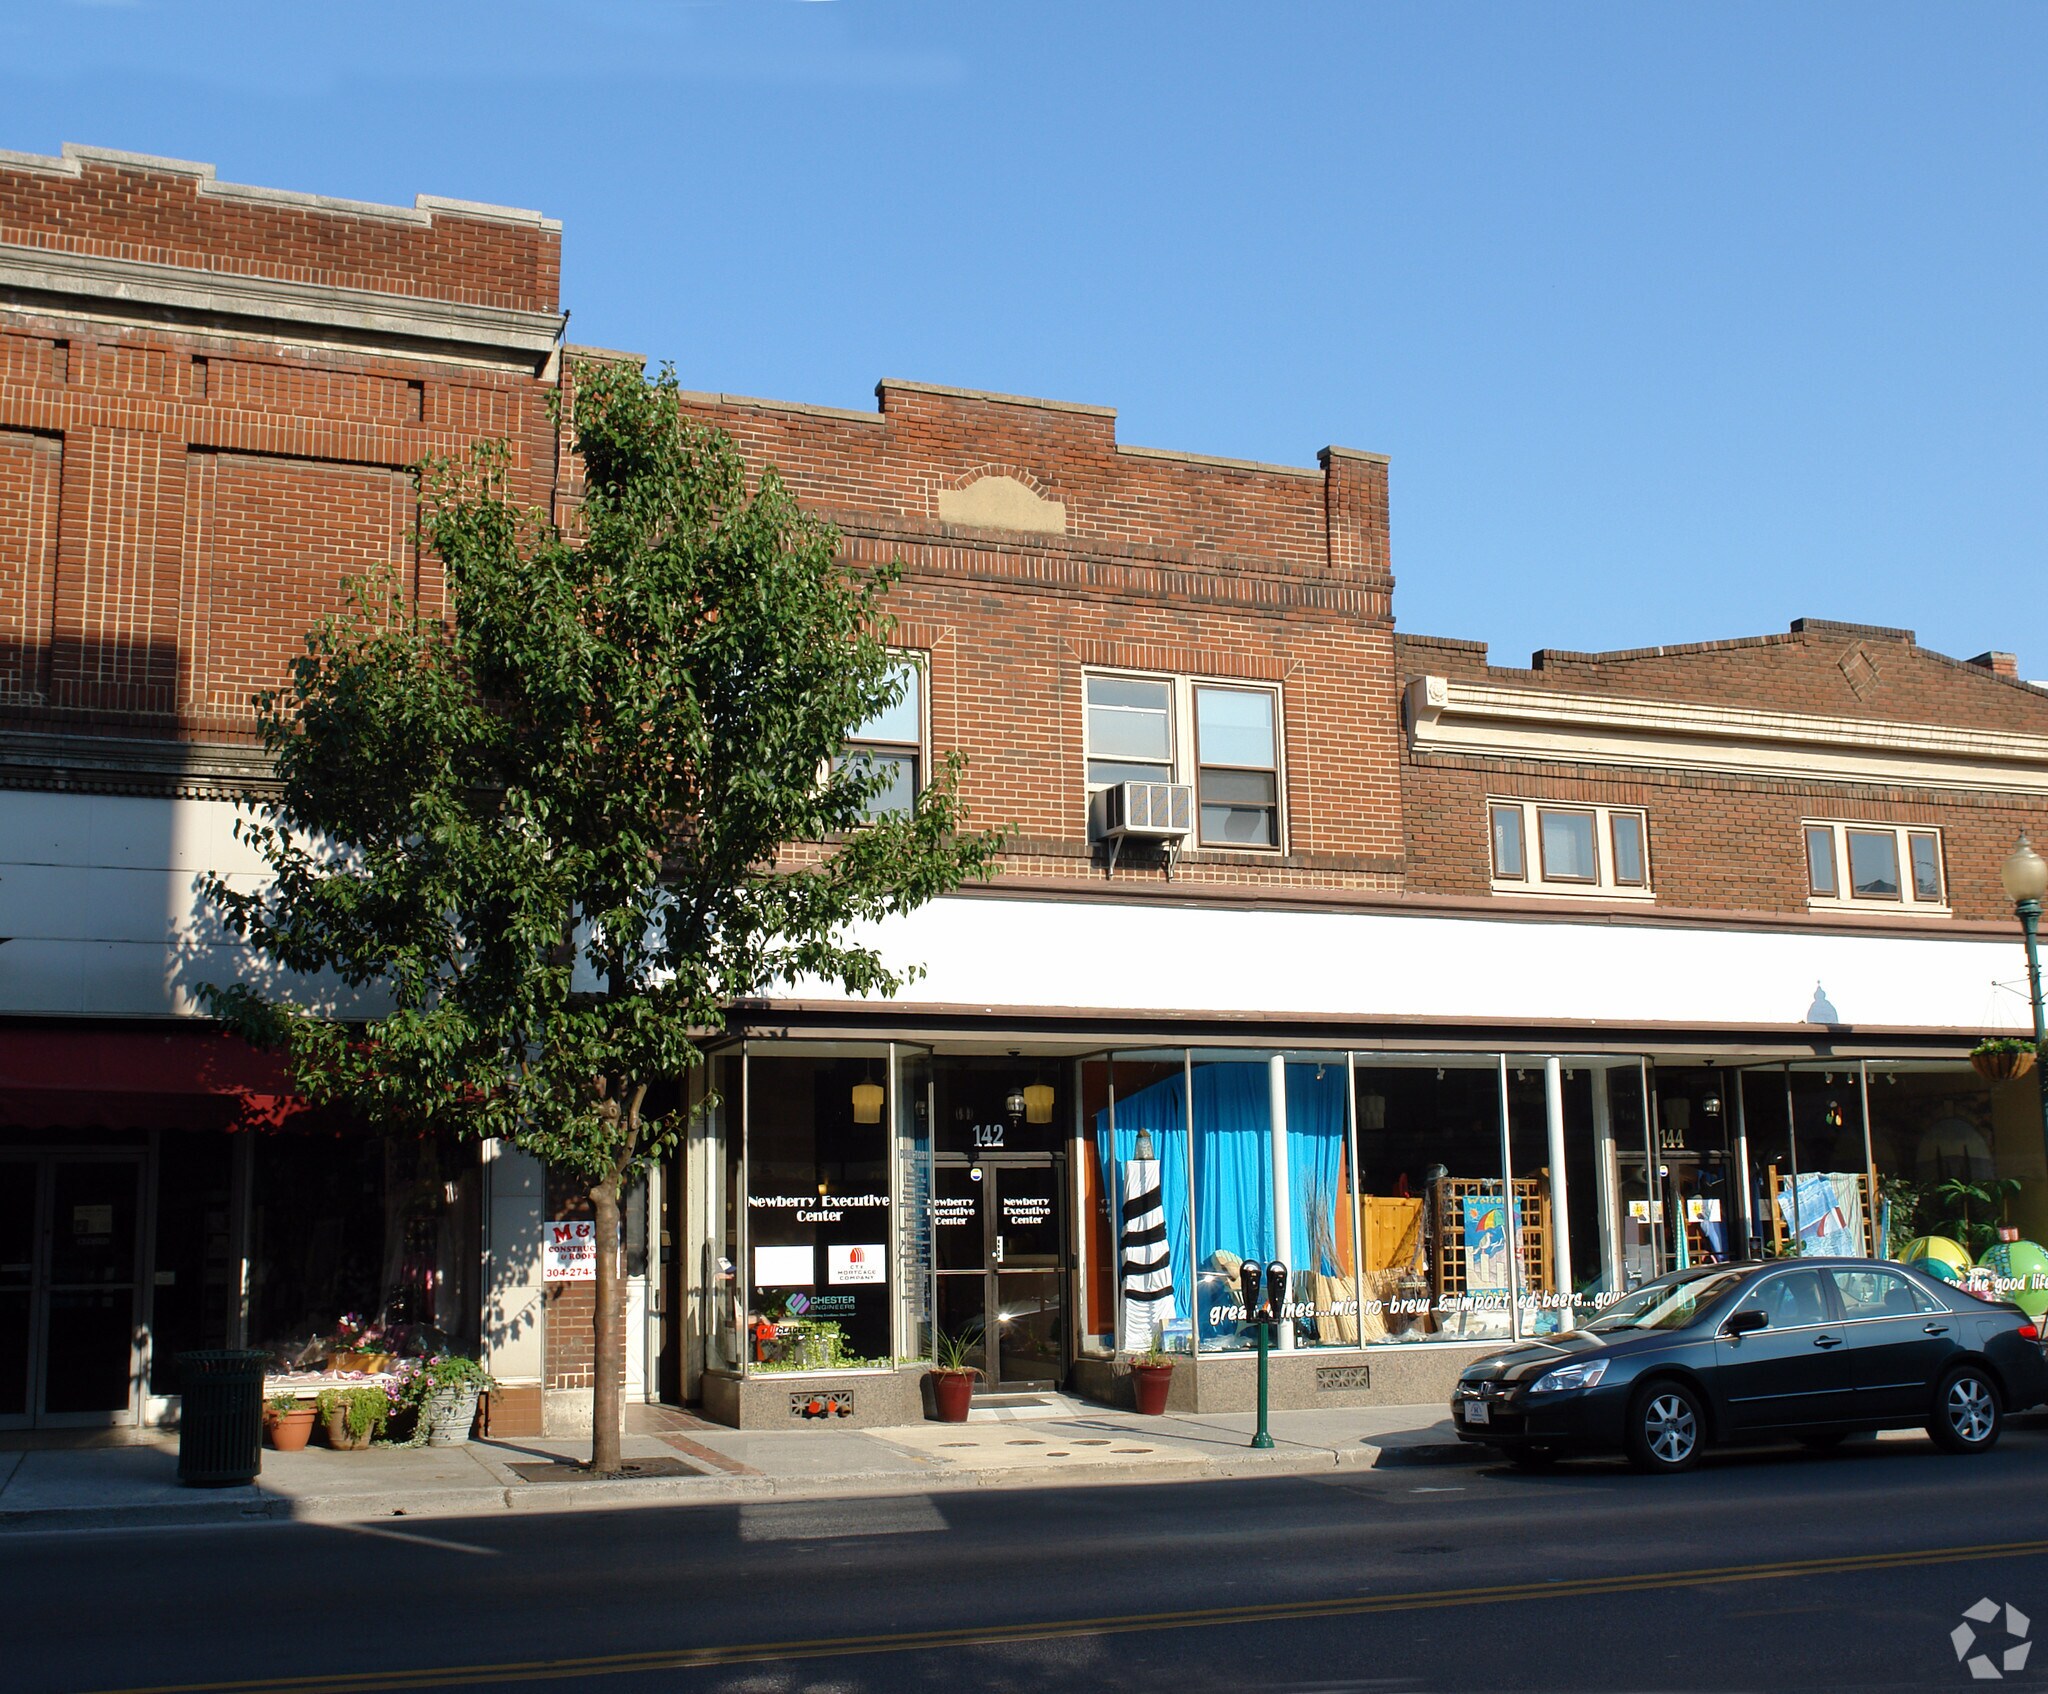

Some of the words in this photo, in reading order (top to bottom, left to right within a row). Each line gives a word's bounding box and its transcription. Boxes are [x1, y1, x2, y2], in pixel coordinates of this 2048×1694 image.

[972, 1124, 1004, 1147] 142
[1659, 1129, 1685, 1149] 144
[748, 1195, 817, 1208] Newberry
[821, 1194, 891, 1207] Executive
[1003, 1197, 1050, 1206] Newberry
[796, 1209, 844, 1223] Center
[1003, 1206, 1051, 1216] Executive
[934, 1216, 968, 1226] Center
[1011, 1216, 1044, 1225] Center
[575, 1224, 591, 1238] &
[548, 1245, 597, 1253] CONSTRUC
[546, 1267, 597, 1278] 304-274-
[1967, 1274, 1989, 1292] the
[1994, 1273, 2026, 1294] good
[810, 1295, 855, 1305] CHESTER
[1209, 1303, 1249, 1326] grea
[1438, 1293, 1449, 1313] &
